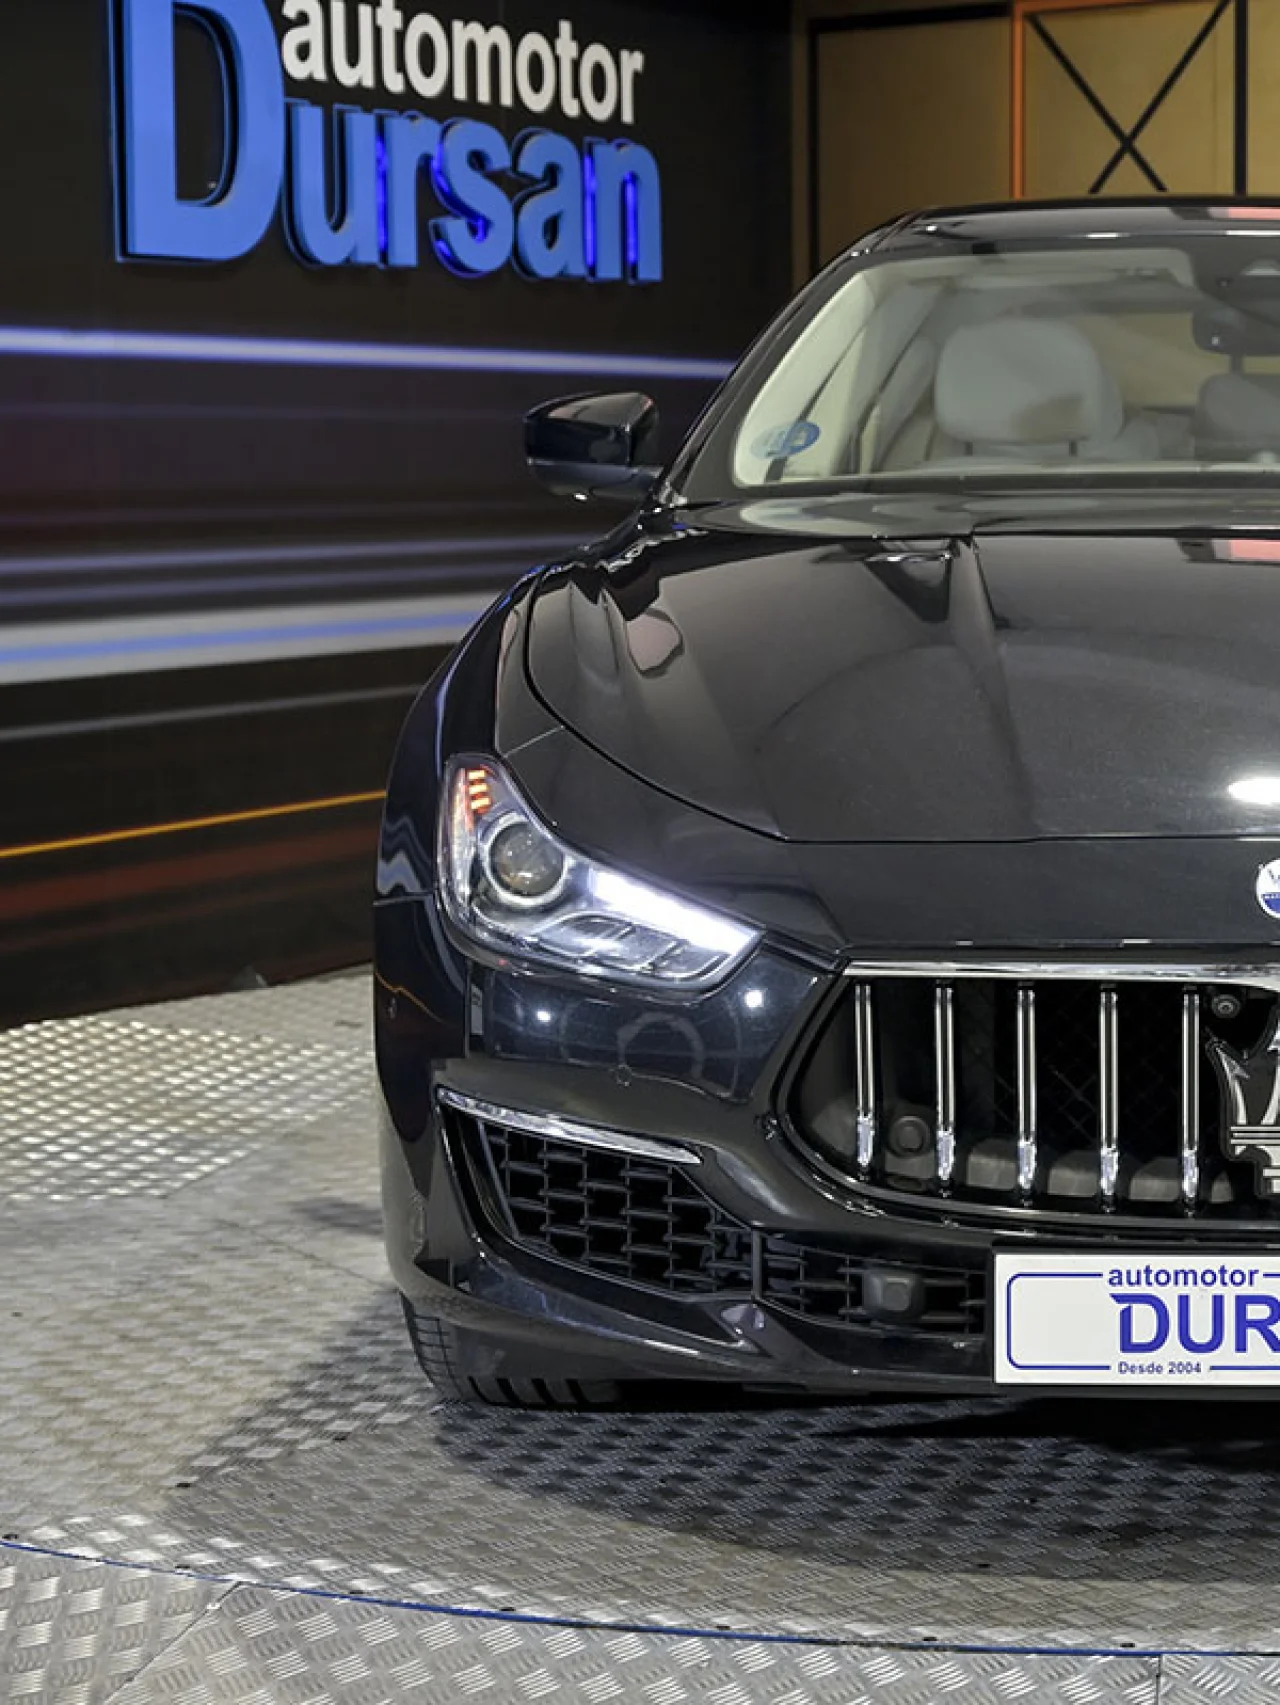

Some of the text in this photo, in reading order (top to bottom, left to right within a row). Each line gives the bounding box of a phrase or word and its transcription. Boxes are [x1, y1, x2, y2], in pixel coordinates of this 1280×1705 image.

[281, 0, 644, 124] automotor
[110, 0, 663, 282] Dursan
[1108, 1265, 1260, 1288] automotor
[1117, 1360, 1202, 1375] Desde 2004
